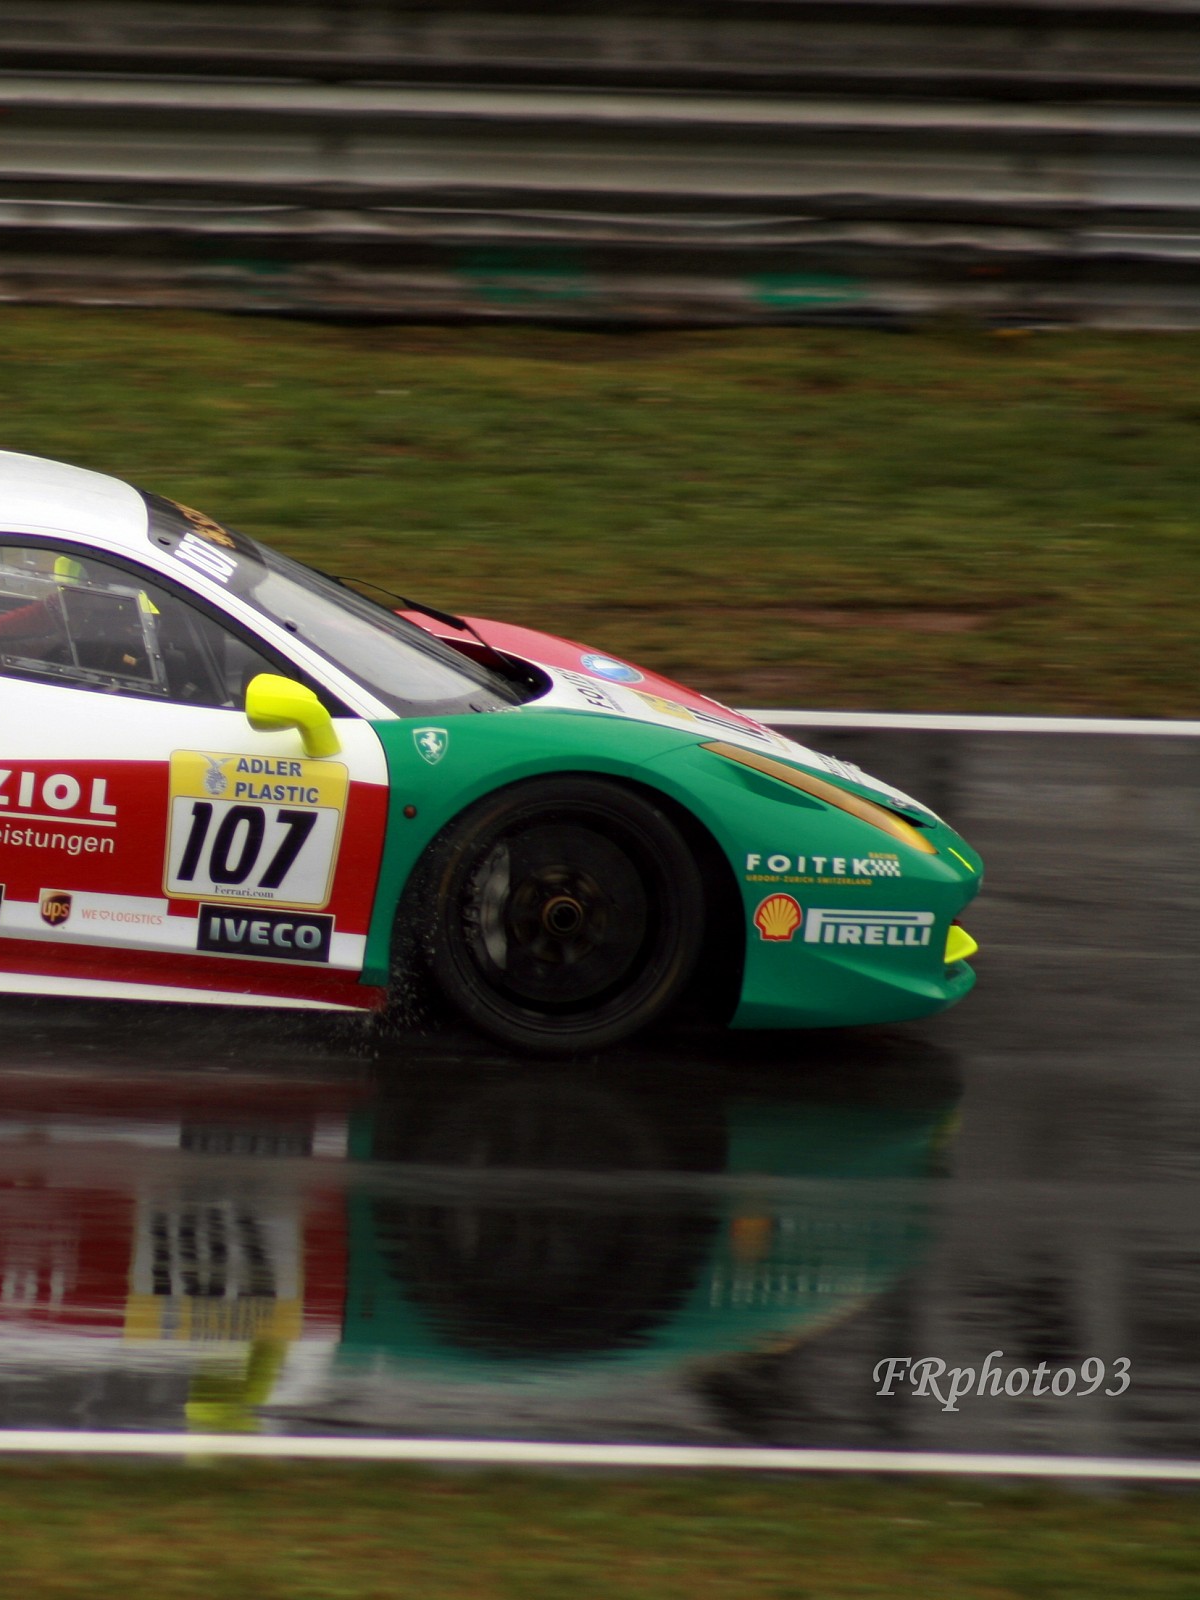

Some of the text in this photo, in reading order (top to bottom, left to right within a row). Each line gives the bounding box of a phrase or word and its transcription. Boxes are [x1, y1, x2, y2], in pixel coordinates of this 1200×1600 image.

[173, 532, 238, 584] 107
[235, 757, 303, 778] ADLER
[234, 781, 320, 805] PLASTIC
[175, 801, 319, 890] 107
[746, 853, 871, 876] FOITEK
[213, 884, 275, 899] Ferrari.com
[41, 899, 71, 923] ups
[81, 908, 164, 926] WE LOGISTICS
[208, 916, 323, 951] IVECO
[804, 907, 936, 946] PIRELLI
